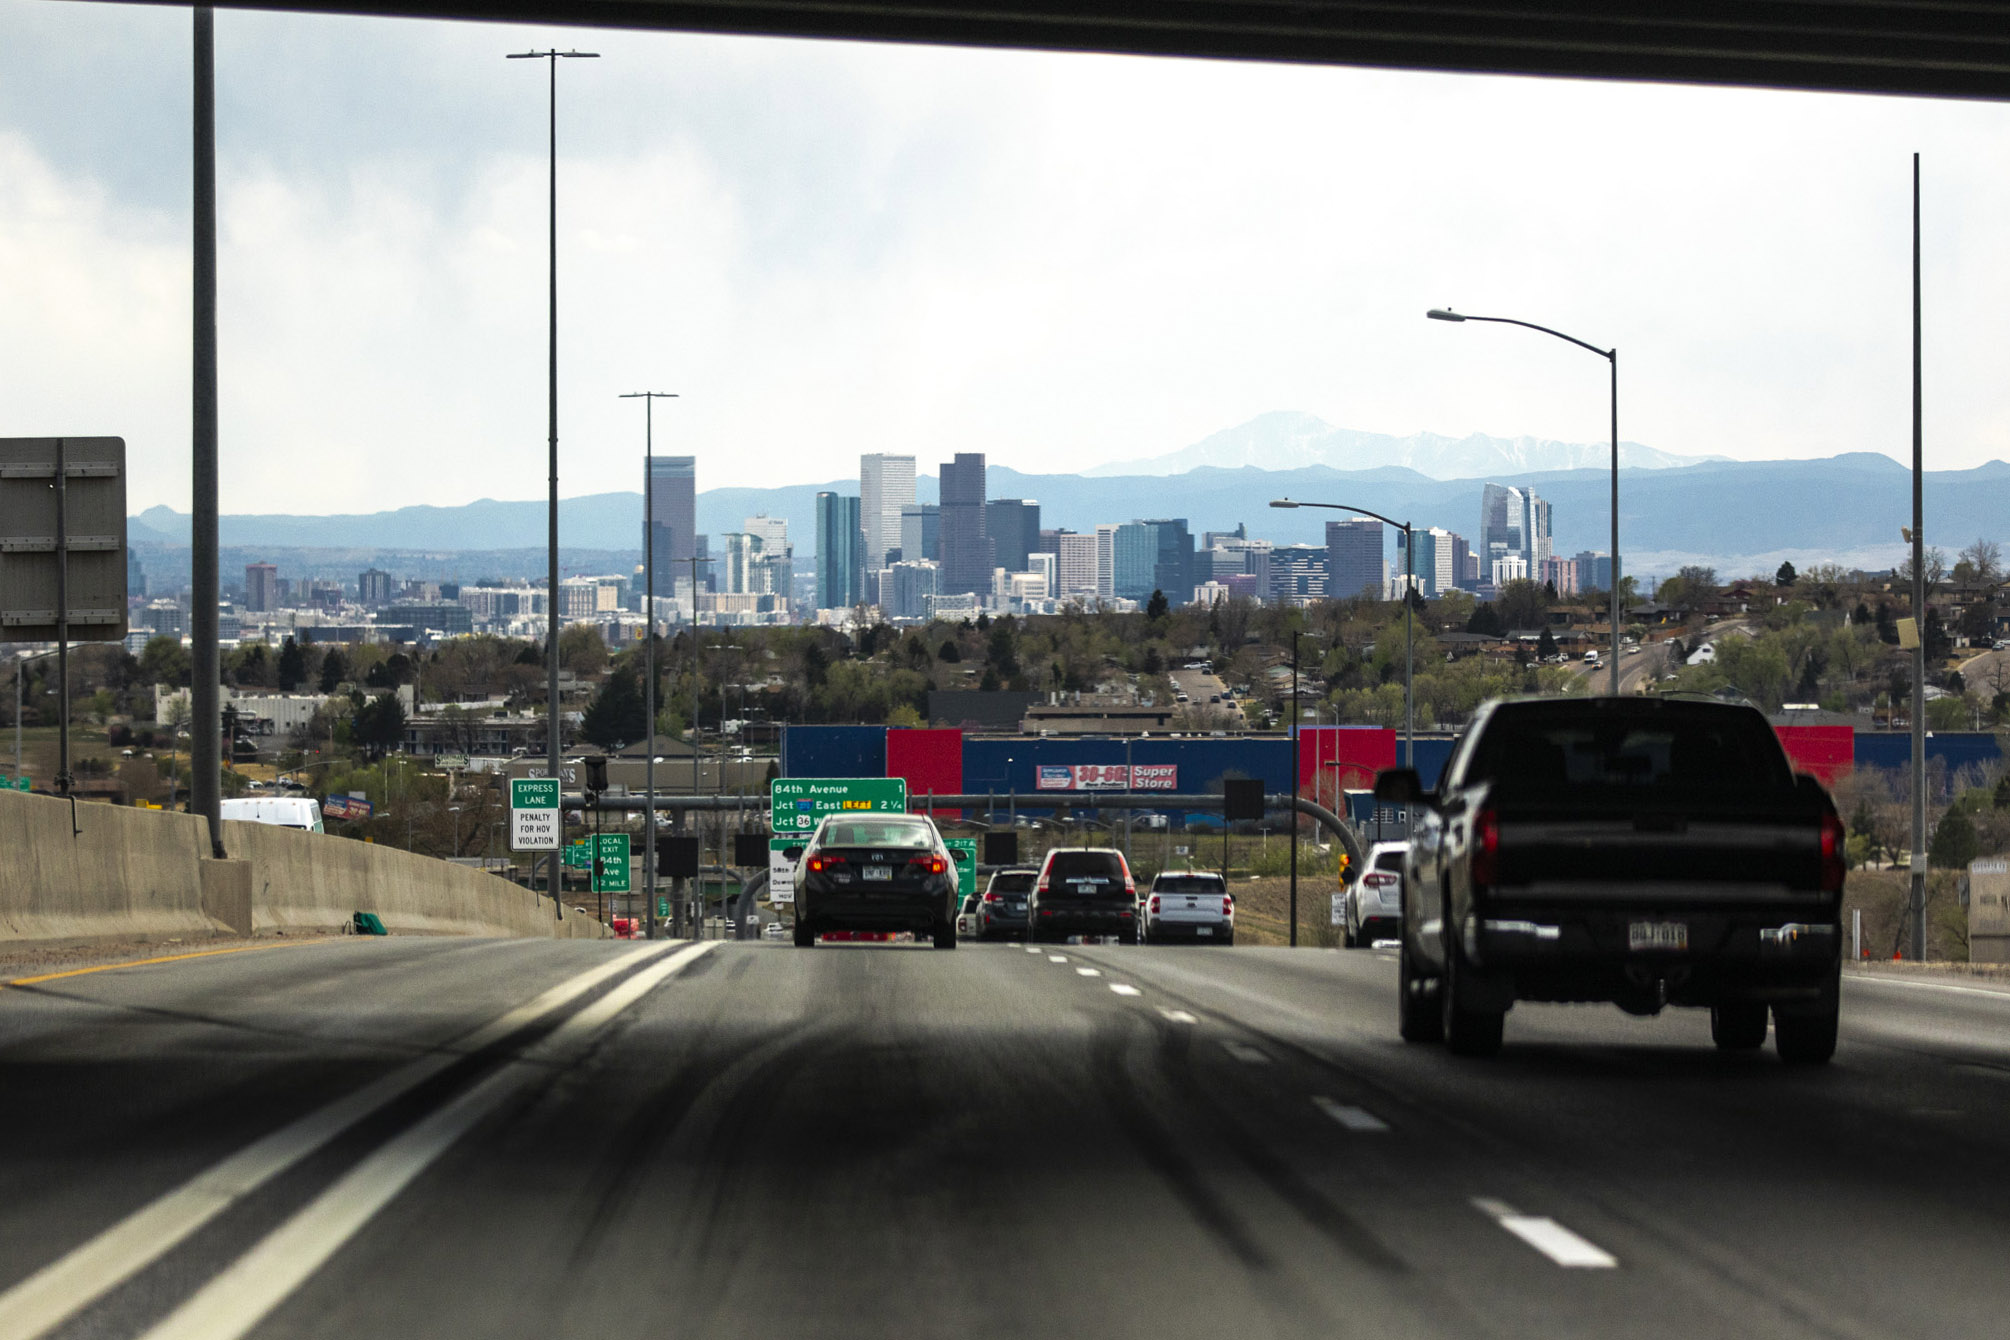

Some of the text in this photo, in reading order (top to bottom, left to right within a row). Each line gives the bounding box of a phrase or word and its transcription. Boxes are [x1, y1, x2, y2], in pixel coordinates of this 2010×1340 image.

[1134, 766, 1174, 778] Super
[1136, 778, 1172, 788] Store
[518, 784, 554, 793] EXPRESS
[774, 784, 903, 793] 84th Avenue 1
[524, 796, 546, 805] LANE
[775, 801, 794, 810] Jct
[815, 801, 841, 810] East
[844, 801, 869, 809] LEFT
[880, 800, 888, 809] 2
[520, 813, 551, 822] PENALTY
[775, 817, 794, 826] Jct
[798, 816, 810, 825] 36
[520, 825, 551, 833] FOR HOV
[518, 836, 554, 845] VIOLATION
[600, 856, 622, 864] 84th
[603, 868, 620, 876] Ave
